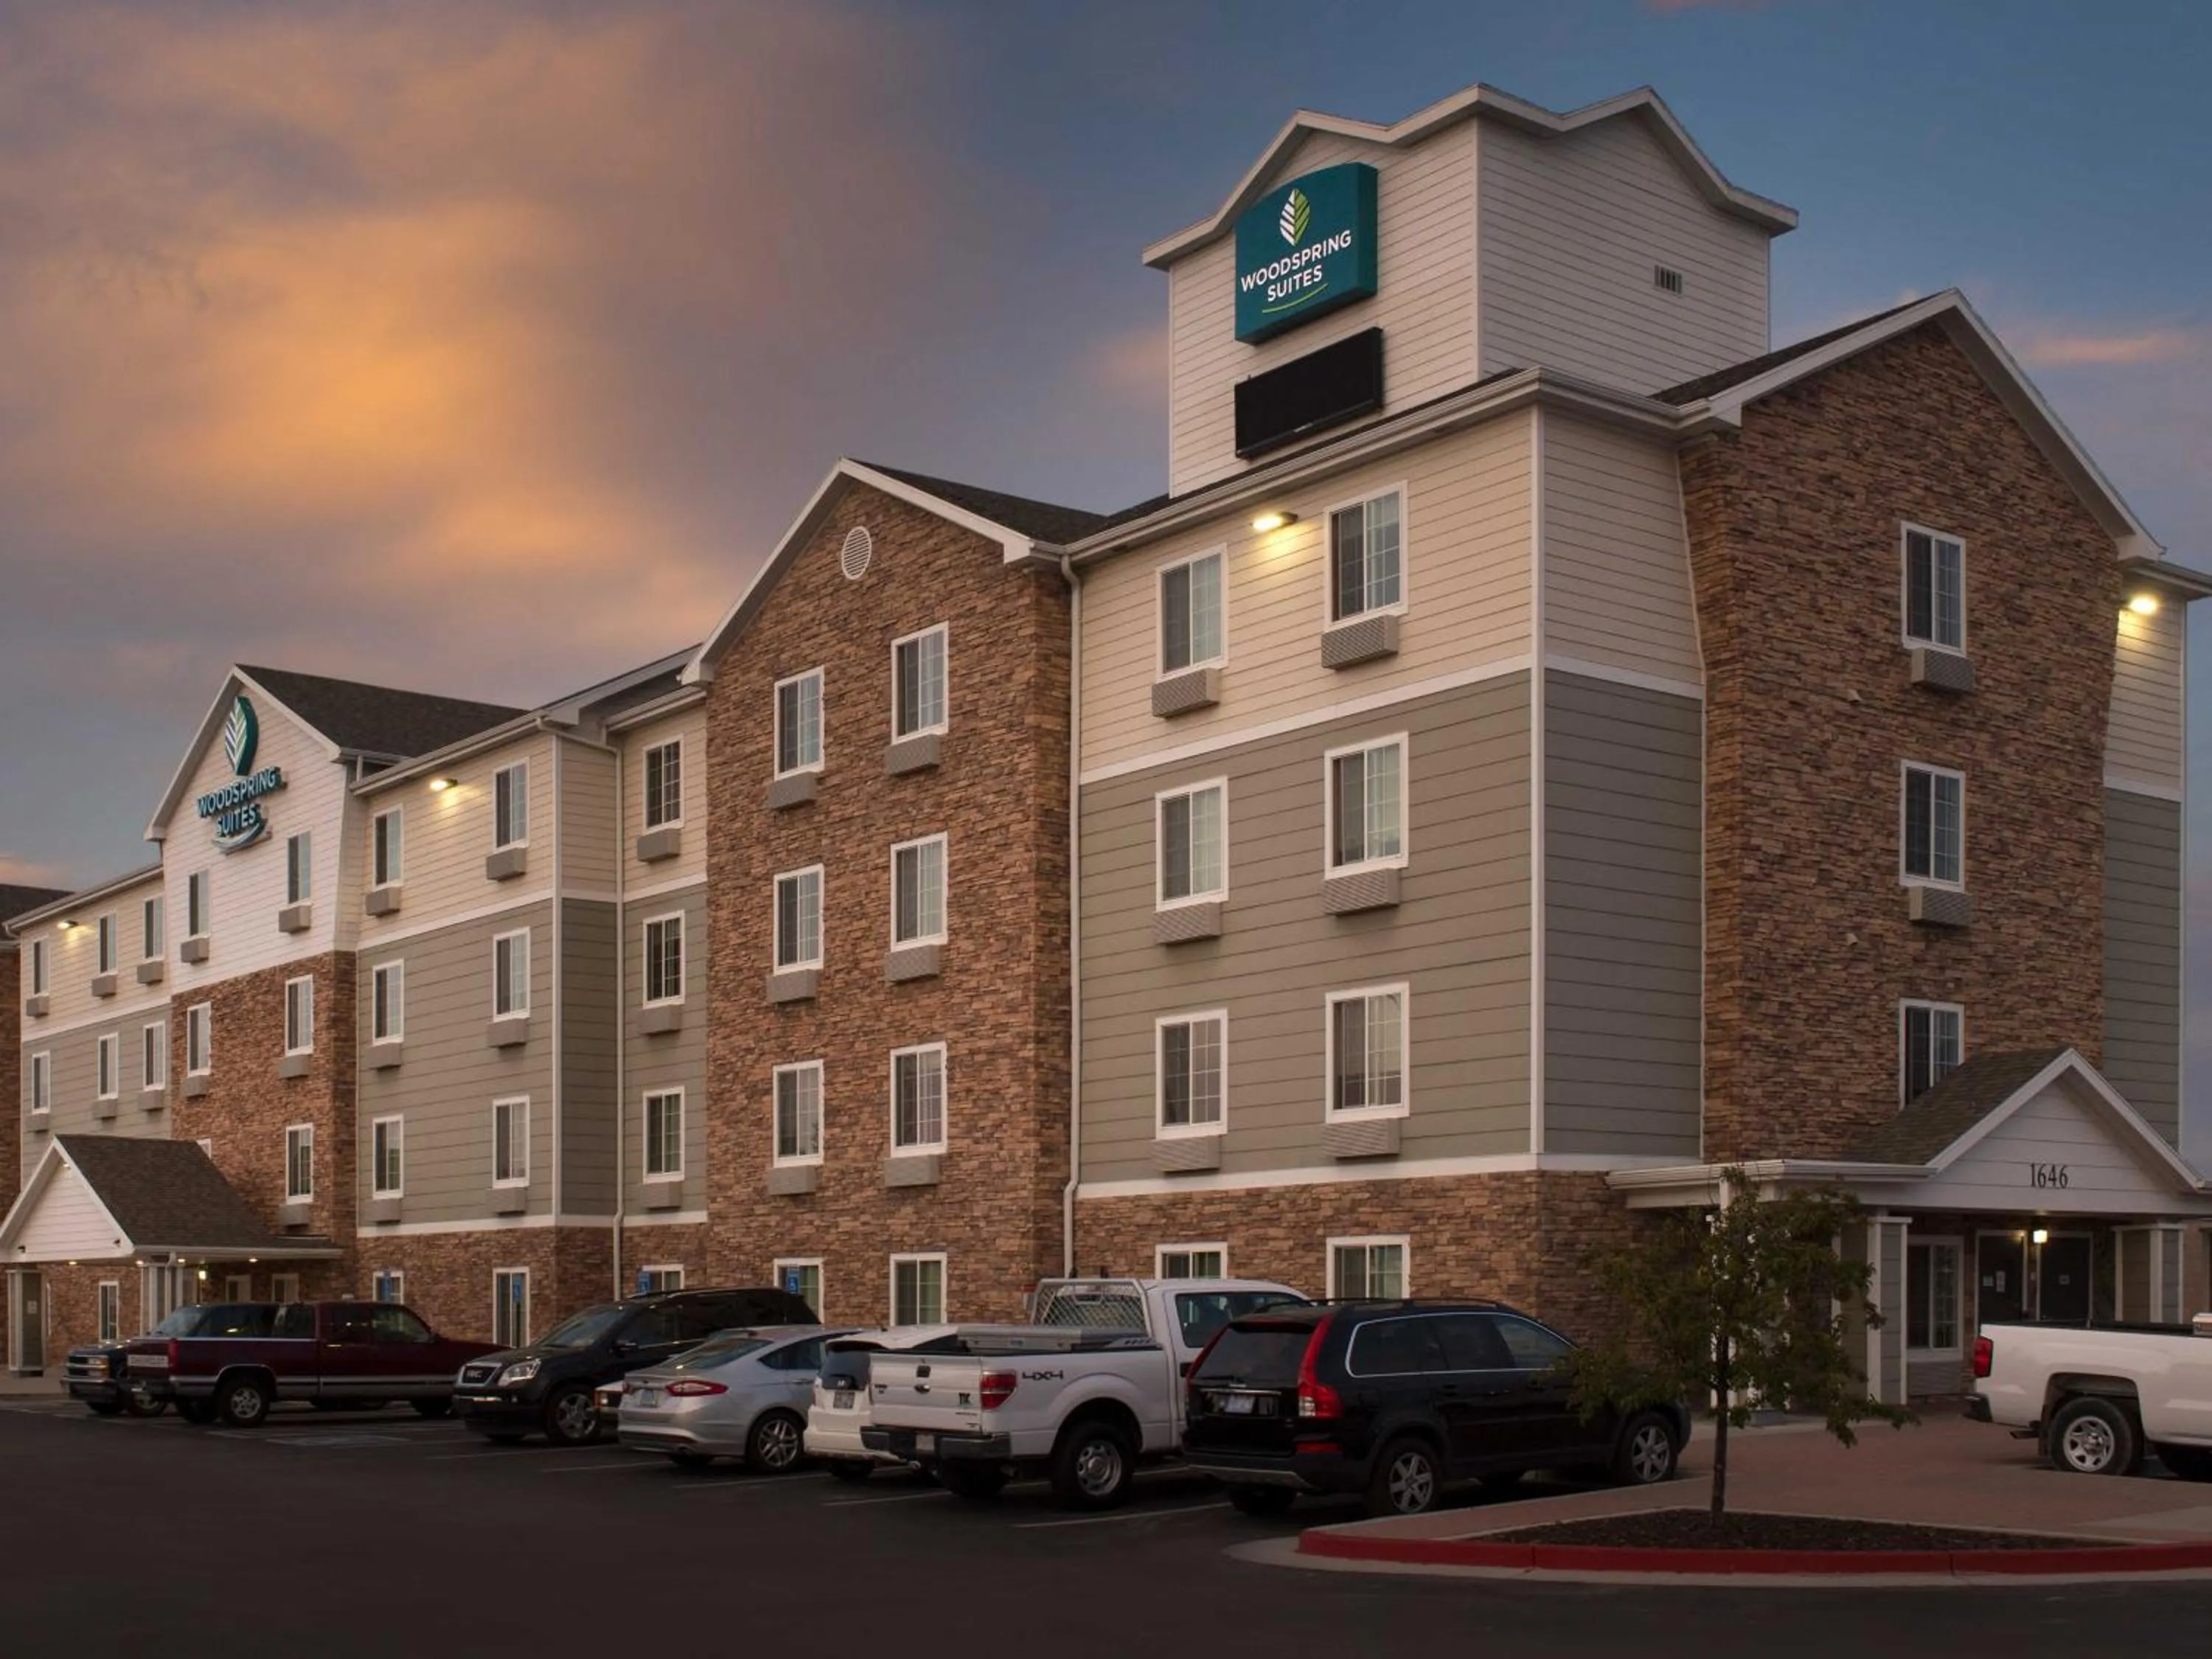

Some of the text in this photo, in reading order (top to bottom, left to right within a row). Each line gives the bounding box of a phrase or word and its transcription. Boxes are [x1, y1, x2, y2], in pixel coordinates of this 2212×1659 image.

[1241, 229, 1352, 293] WOODSPRING
[1267, 264, 1323, 302] SUITES
[196, 765, 281, 818] WOODSPRING
[215, 804, 262, 837] SUITES
[2031, 1163, 2068, 1189] 1646
